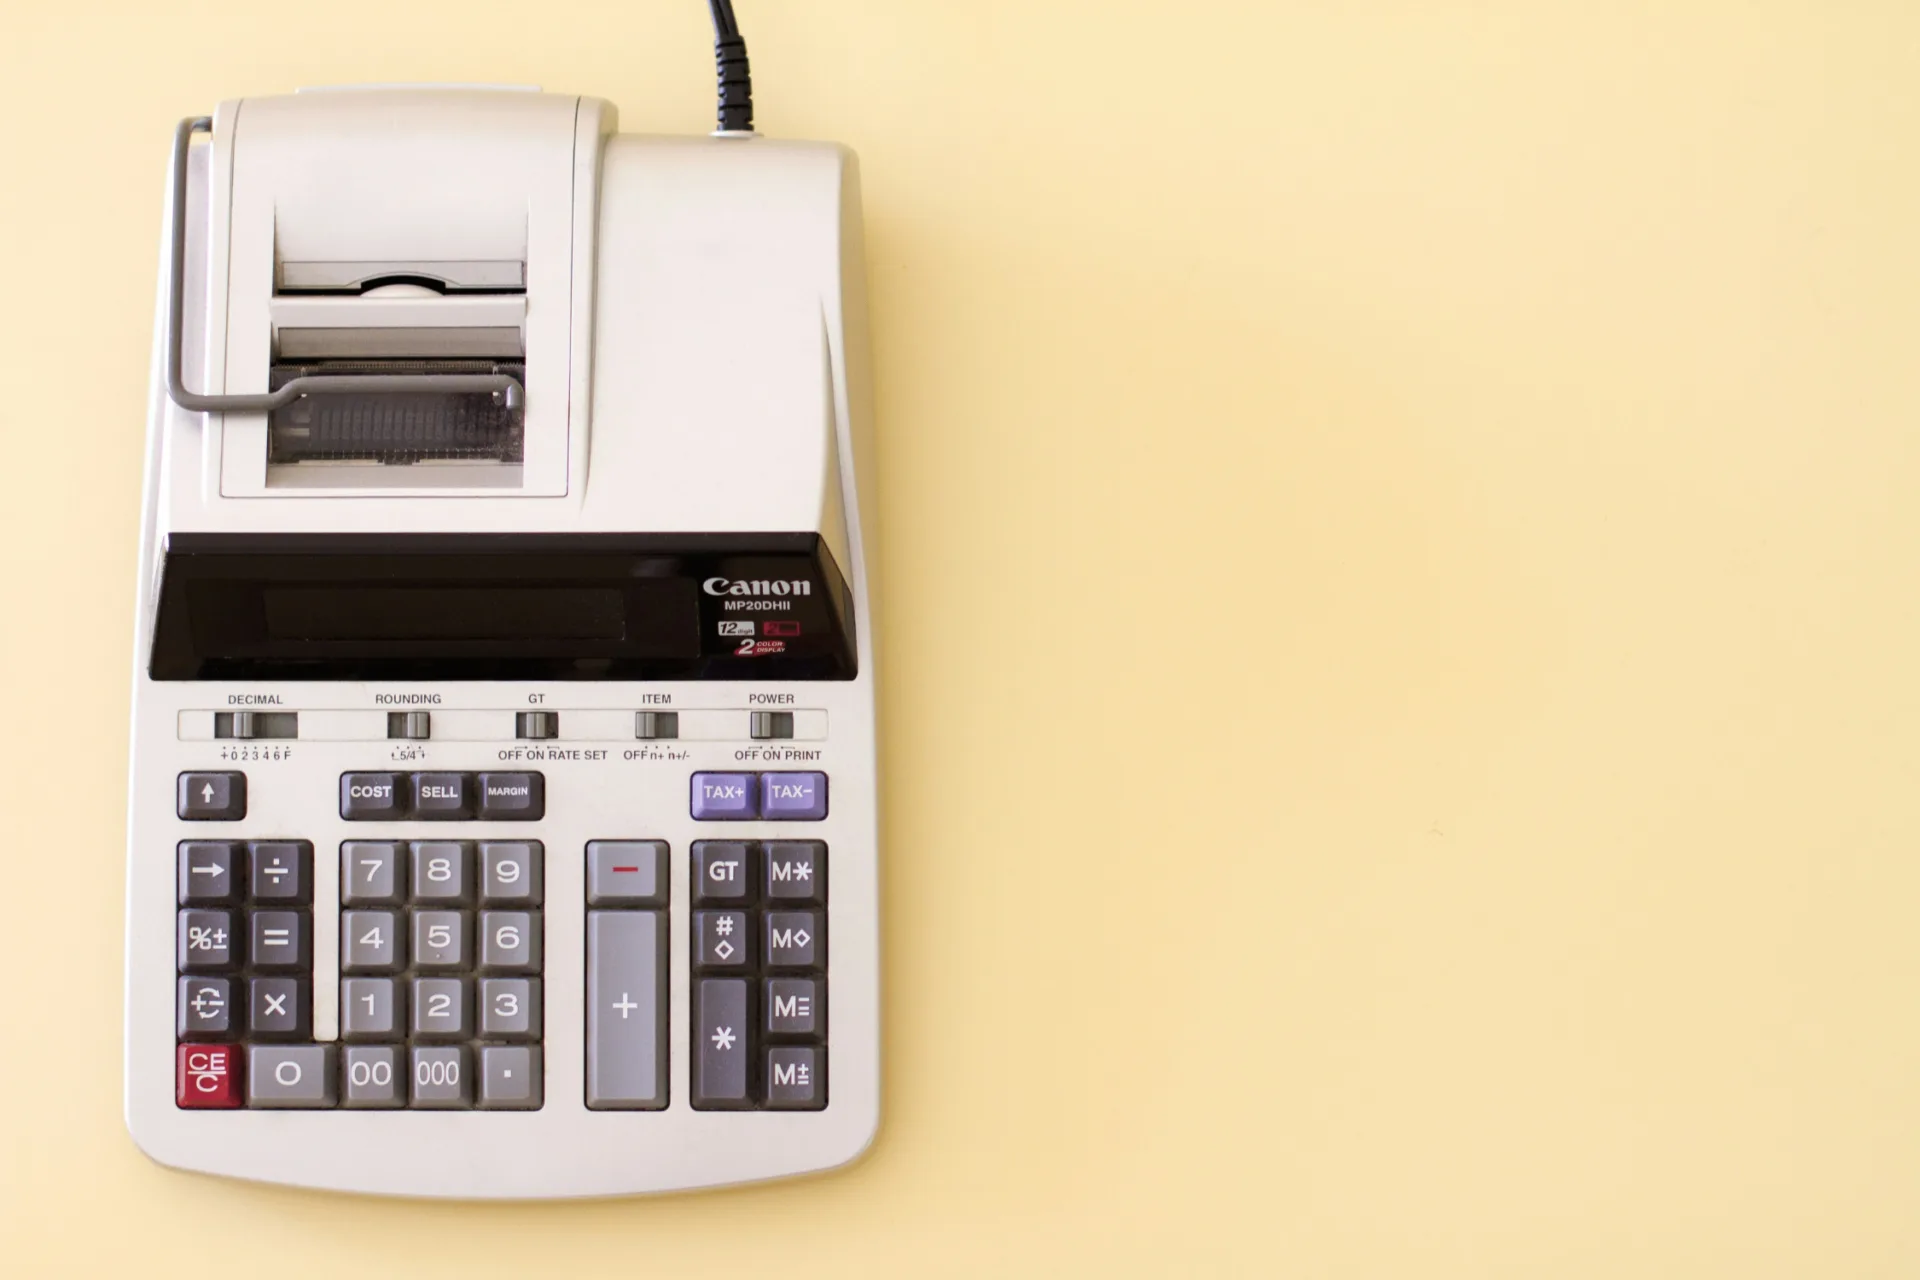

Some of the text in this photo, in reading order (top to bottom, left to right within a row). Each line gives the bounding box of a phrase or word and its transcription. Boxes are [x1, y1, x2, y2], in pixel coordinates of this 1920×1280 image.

[703, 577, 811, 596] Canon
[724, 601, 791, 610] MP20DHII
[721, 622, 738, 634] 12
[738, 638, 755, 655] 2
[228, 695, 283, 705] DECIMAL
[375, 694, 441, 704] ROUNDING
[528, 694, 545, 704] GT
[642, 694, 672, 704] ITEM
[749, 694, 795, 704] POWER
[498, 750, 608, 760] OFF ON RATE SET
[623, 750, 648, 760] OFF
[734, 751, 822, 760] OFF ON PRINT
[350, 786, 391, 798] COST
[421, 785, 458, 798] SELL
[488, 787, 528, 796] MARGIN
[703, 785, 744, 798] TAX+
[772, 785, 812, 798] TAX-
[360, 860, 382, 882] 7
[427, 859, 451, 881] 8
[495, 860, 520, 883] 9
[709, 861, 738, 881] GT
[360, 927, 384, 949] 4
[427, 925, 451, 948] 5
[495, 926, 520, 949] 6
[361, 994, 375, 1016] 1
[428, 994, 451, 1017] 2
[494, 994, 519, 1016] 3
[189, 1053, 226, 1071] CE
[275, 1062, 301, 1085] 0
[351, 1061, 391, 1085] 00
[417, 1061, 459, 1085] 000
[195, 1075, 219, 1093] C
